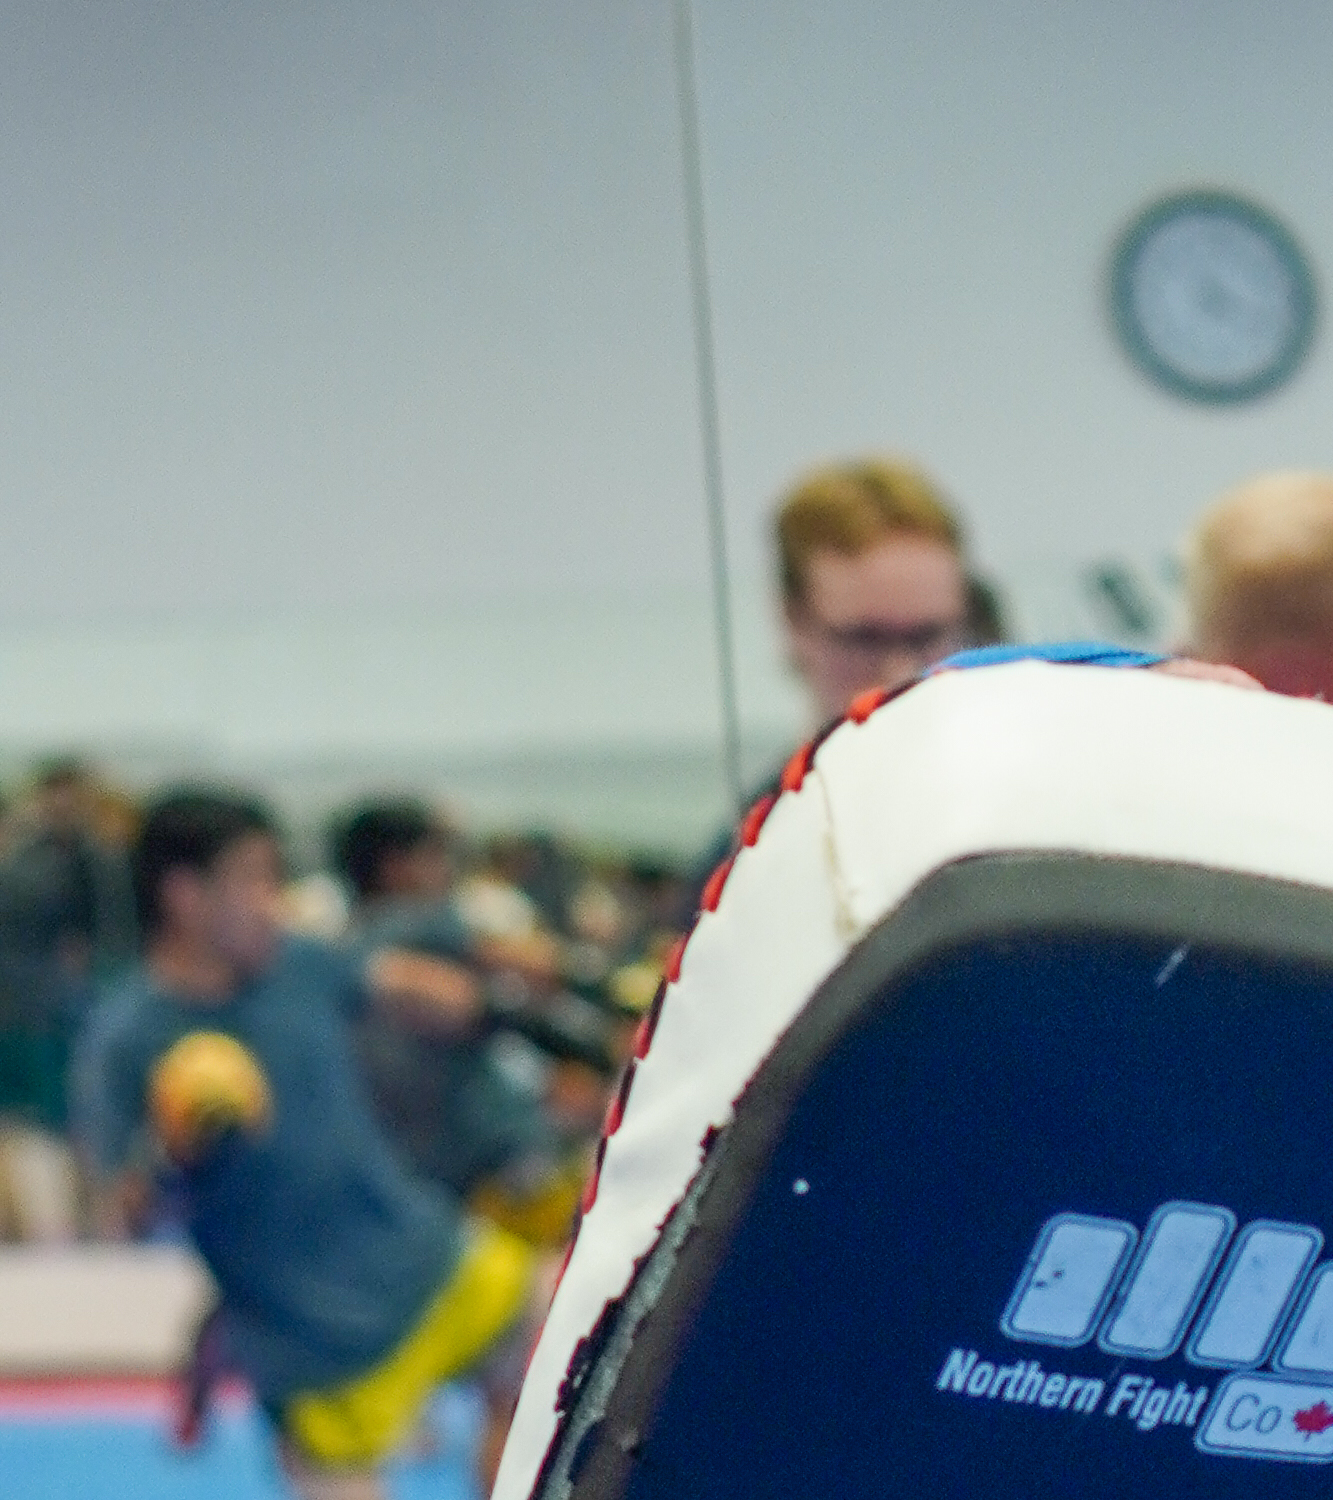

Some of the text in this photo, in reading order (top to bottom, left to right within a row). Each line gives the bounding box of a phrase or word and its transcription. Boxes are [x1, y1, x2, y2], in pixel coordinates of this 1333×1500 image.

[935, 1348, 1283, 1435] Northern Fight Co
